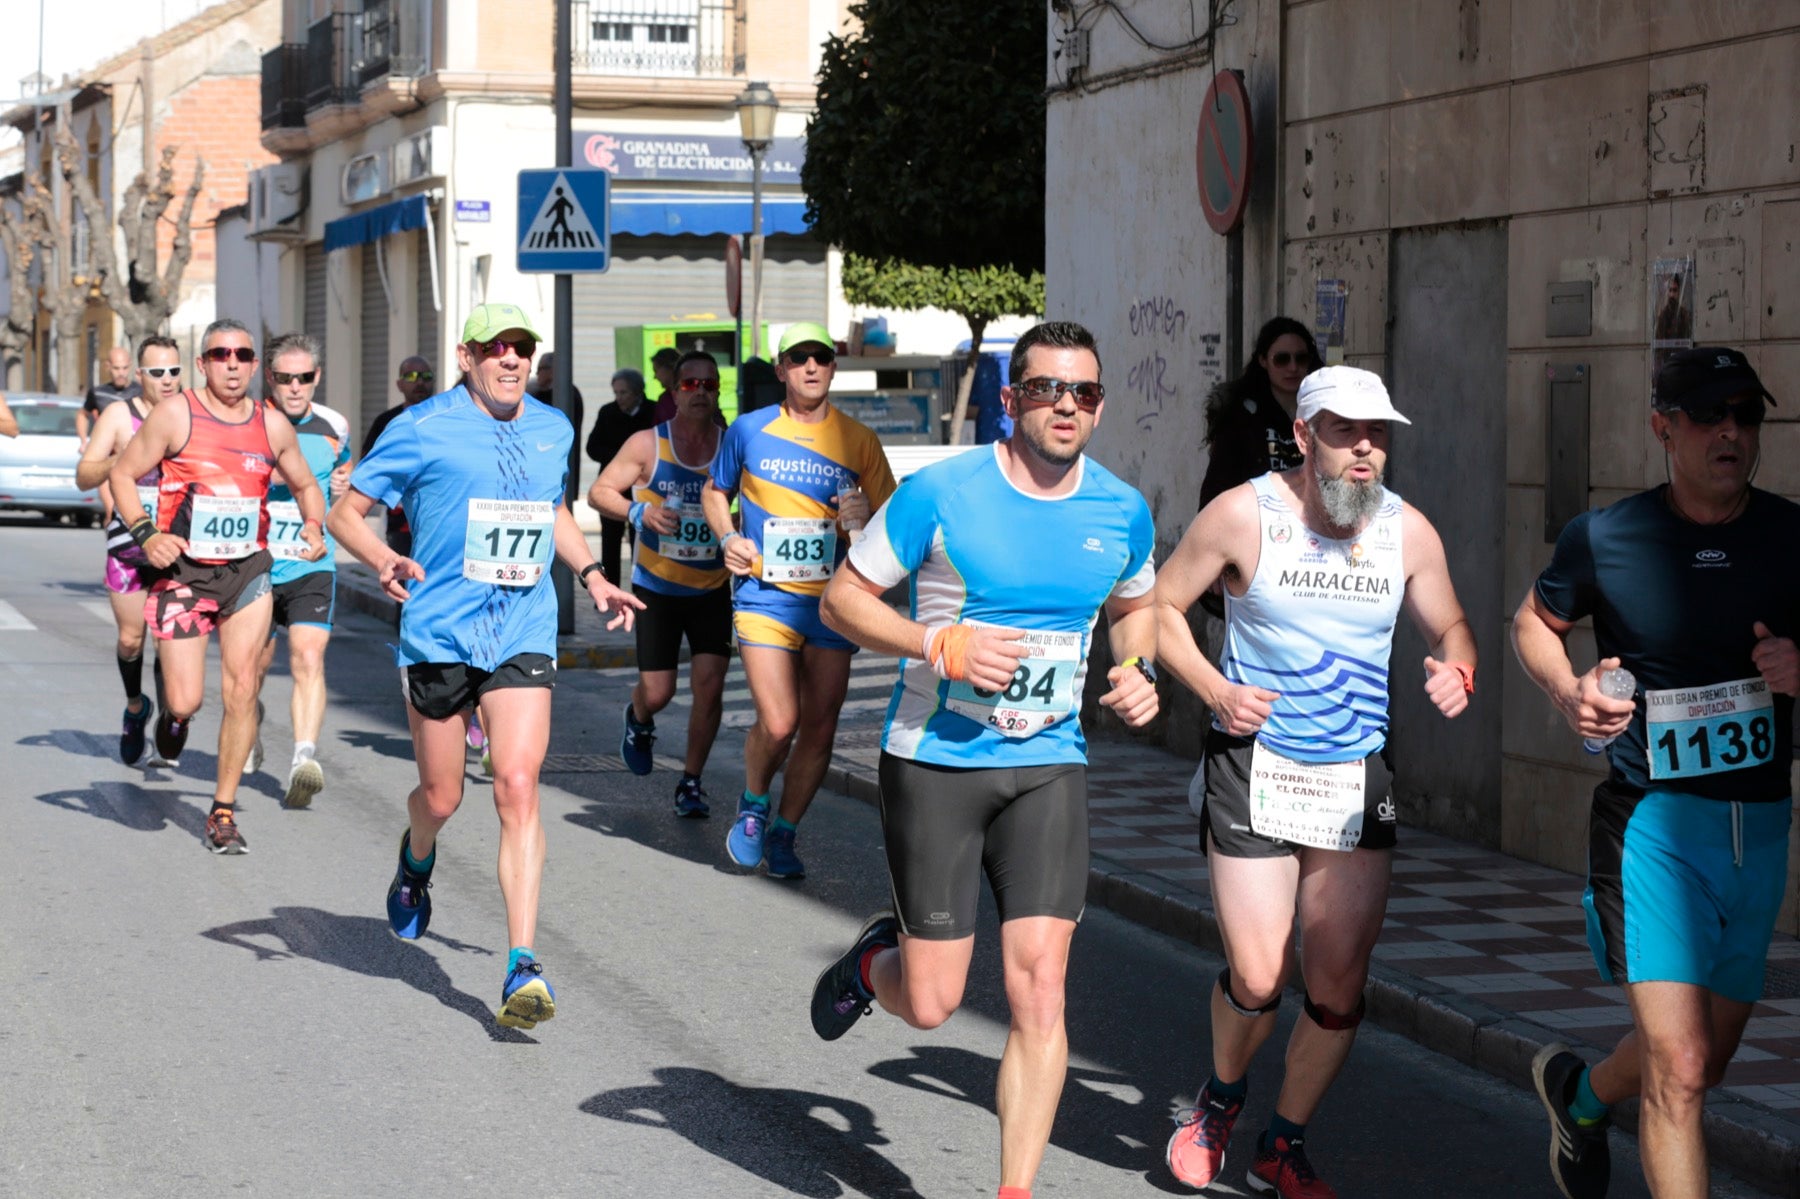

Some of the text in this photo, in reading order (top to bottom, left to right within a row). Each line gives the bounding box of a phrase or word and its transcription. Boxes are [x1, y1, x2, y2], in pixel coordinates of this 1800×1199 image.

[622, 140, 711, 156] GRANADINA
[634, 155, 797, 173] DE ELECTRICIDA, S.L.
[760, 458, 842, 479] agustinos
[771, 473, 830, 486] GRANADA
[493, 503, 509, 512] GRAN
[509, 503, 529, 513] PREMIO
[203, 516, 249, 539] 409
[275, 520, 304, 541] 77
[484, 527, 542, 559] 177
[776, 539, 824, 561] 483
[1278, 569, 1391, 595] MARACENA
[1292, 590, 1380, 604] CLUB DE ATLETISMO
[1020, 632, 1075, 647] REMIO DE FONDO
[973, 664, 1057, 705] 84
[1674, 691, 1698, 704] GRAN
[1699, 686, 1728, 703] PREMIO
[1729, 684, 1740, 697] DE
[1741, 680, 1766, 695] FONDO
[1657, 716, 1772, 772] 1138
[1254, 770, 1269, 780] YO
[1271, 771, 1313, 785] CORRO
[1315, 778, 1361, 792] CONTRA
[1275, 784, 1291, 794] EL
